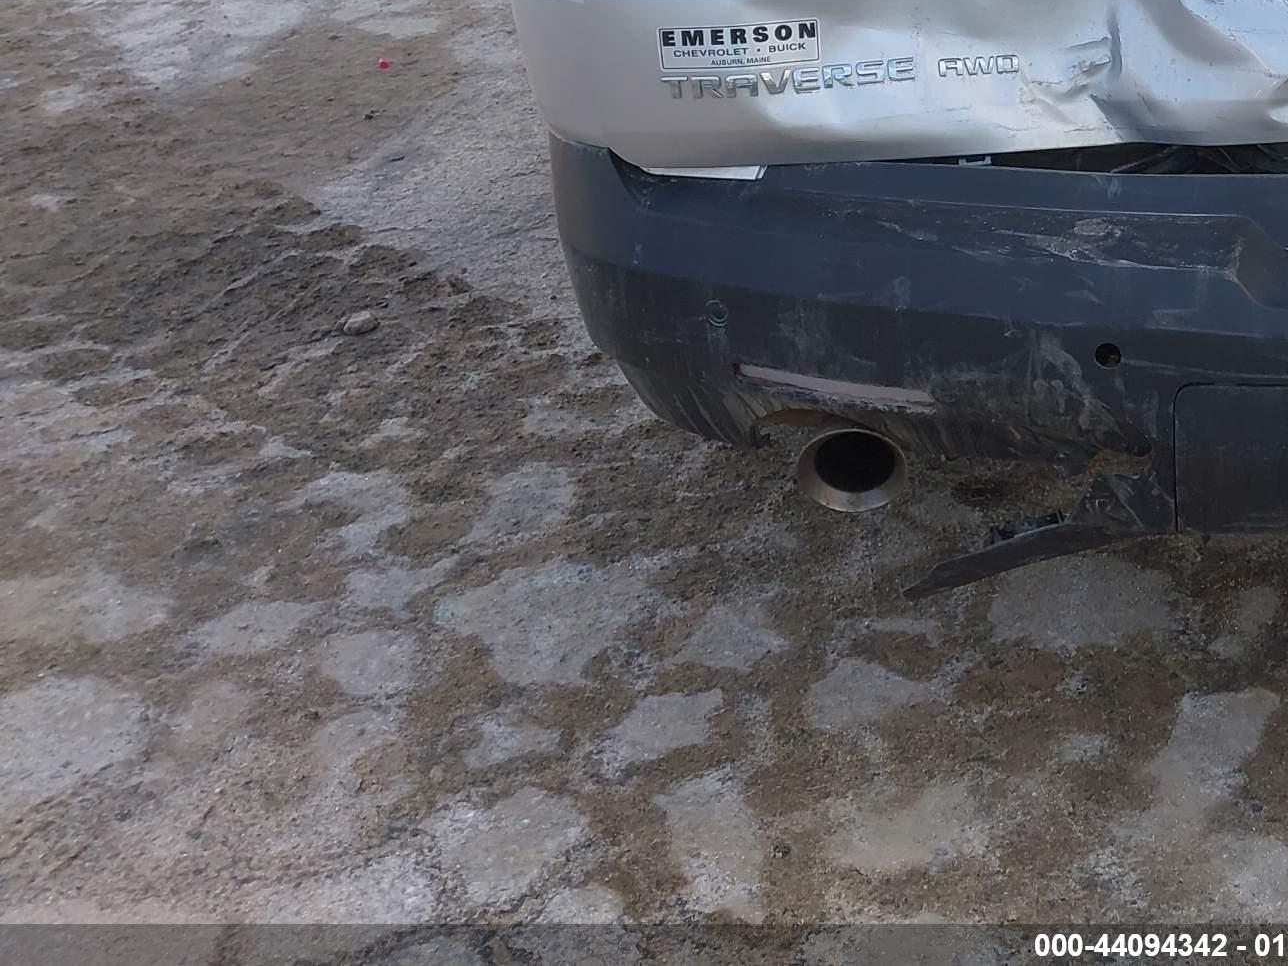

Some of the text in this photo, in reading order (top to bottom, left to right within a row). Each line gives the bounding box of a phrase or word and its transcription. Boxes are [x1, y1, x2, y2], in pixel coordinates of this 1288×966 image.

[662, 22, 816, 47] EMERSON
[673, 42, 806, 58] CHEVROLET BUICK
[711, 55, 771, 66] AUBURN, MAINE
[660, 54, 1020, 99] TRAVERSE AWD
